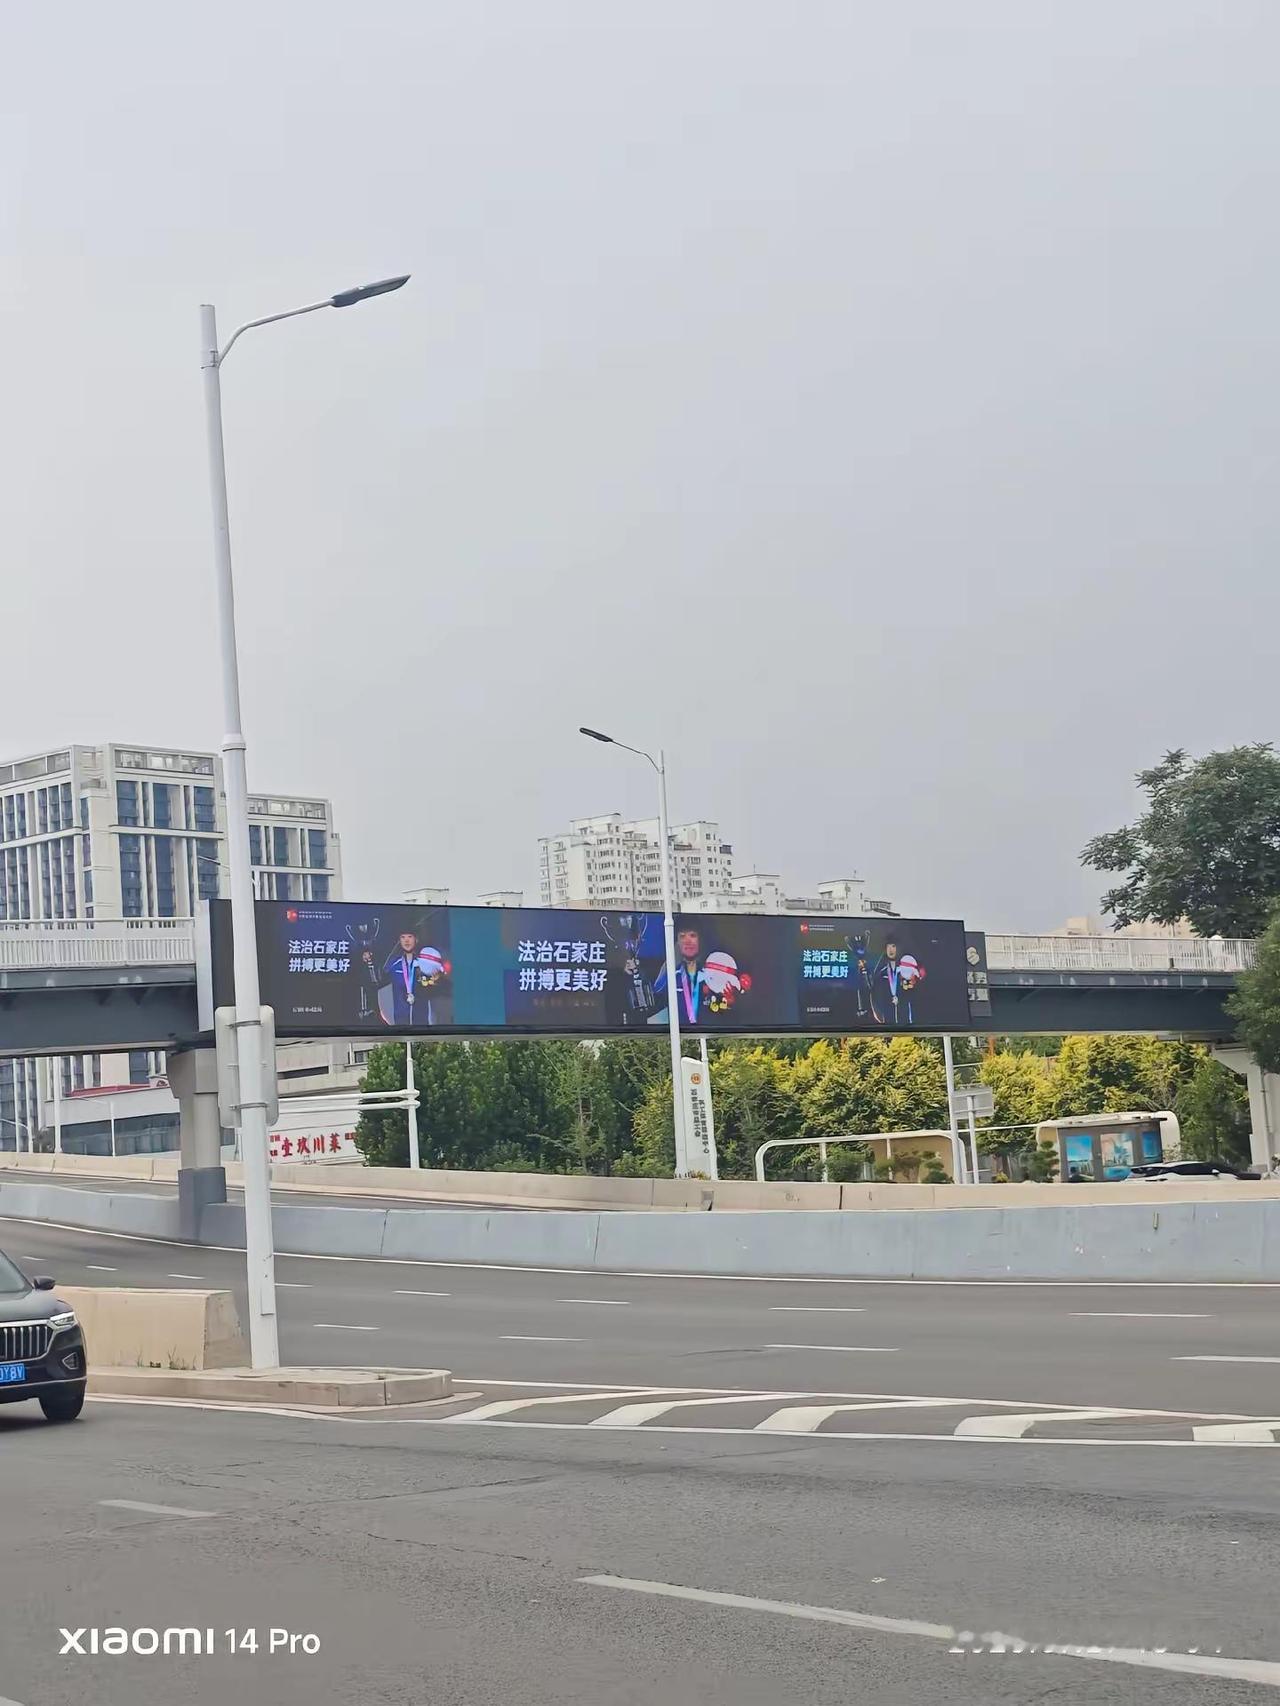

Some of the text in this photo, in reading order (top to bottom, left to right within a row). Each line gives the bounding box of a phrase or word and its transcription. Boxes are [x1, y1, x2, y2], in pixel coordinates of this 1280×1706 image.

[289, 939, 350, 954] 法治石家庄
[518, 940, 606, 963] 法治石家庄
[803, 949, 848, 963] 法治石家庄
[289, 957, 350, 972] 拼搏更美好
[803, 965, 849, 978] 拼搏更美好
[519, 968, 608, 991] 拼搏更美好
